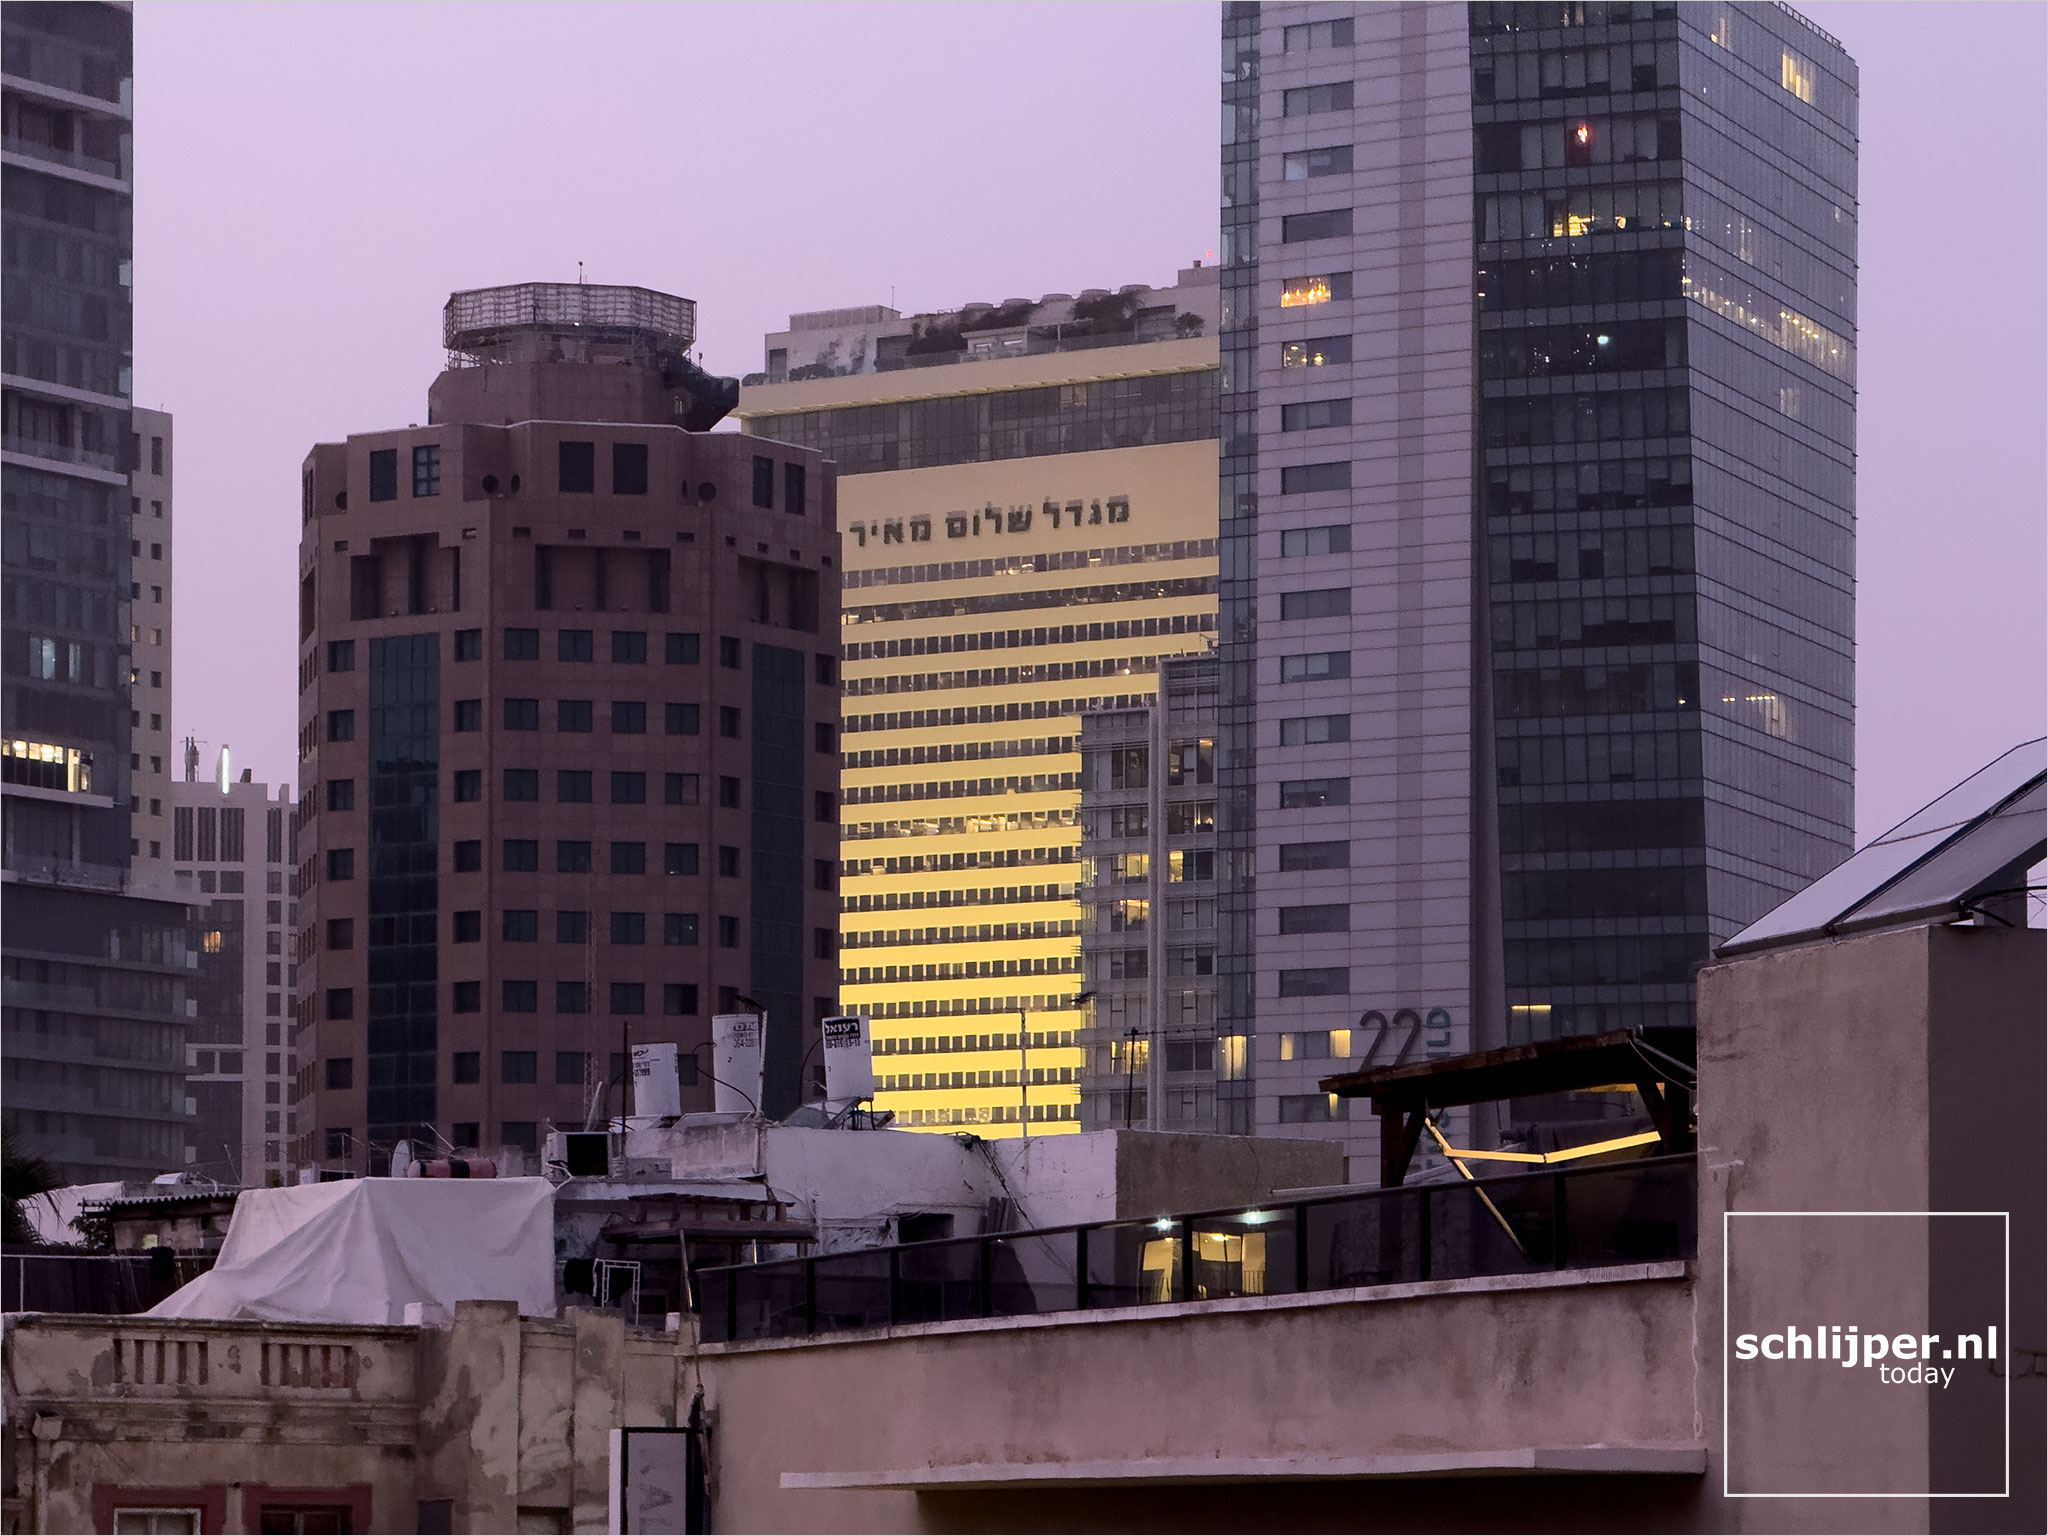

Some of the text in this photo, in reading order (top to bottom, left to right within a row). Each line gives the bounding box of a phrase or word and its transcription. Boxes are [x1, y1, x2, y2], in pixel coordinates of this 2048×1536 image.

[849, 495, 1130, 547] מגדל שלום מאיר
[1359, 1008, 1421, 1073] 22
